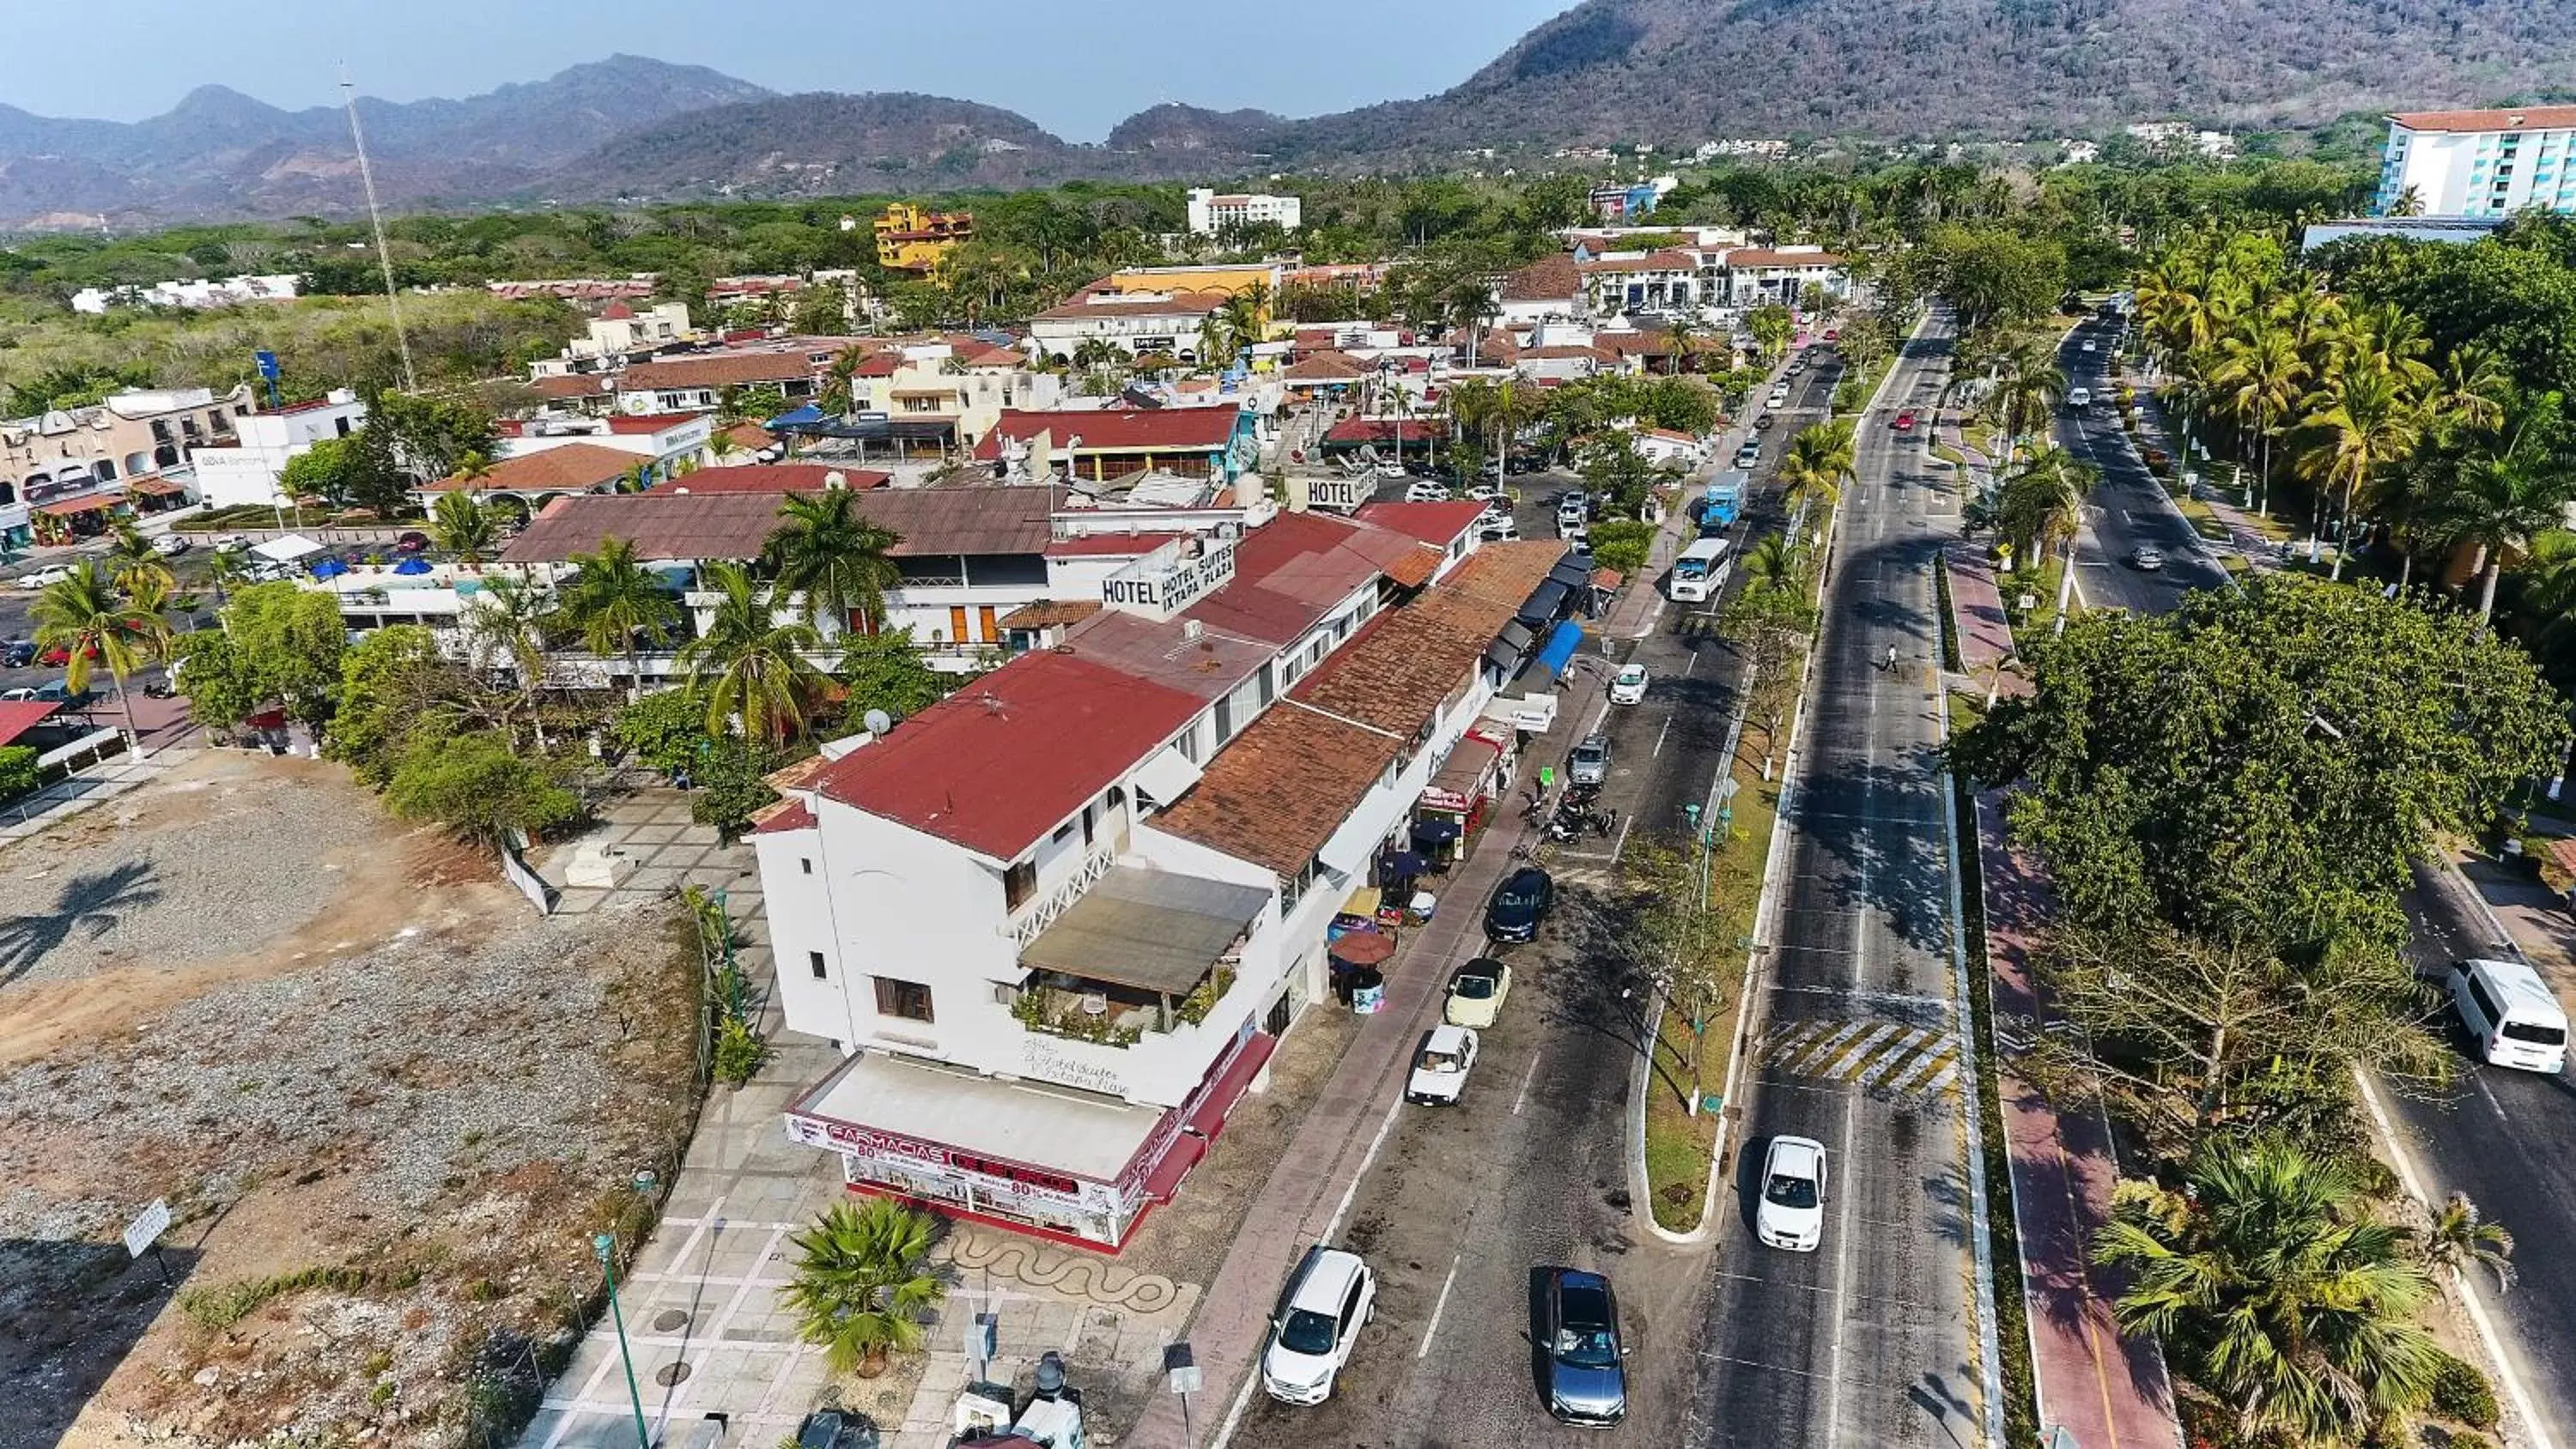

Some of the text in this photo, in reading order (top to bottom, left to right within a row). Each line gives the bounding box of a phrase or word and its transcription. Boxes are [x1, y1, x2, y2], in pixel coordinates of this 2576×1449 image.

[1308, 482, 1354, 504] HOTEL
[1162, 543, 1232, 596] HOTEL SUITES
[1102, 579, 1158, 604] HOTEL
[1163, 561, 1233, 612] IXTAPA PLAZA
[829, 1125, 945, 1163] FARMACIAS
[858, 1147, 875, 1158] 80
[1011, 1181, 1030, 1196] 80
